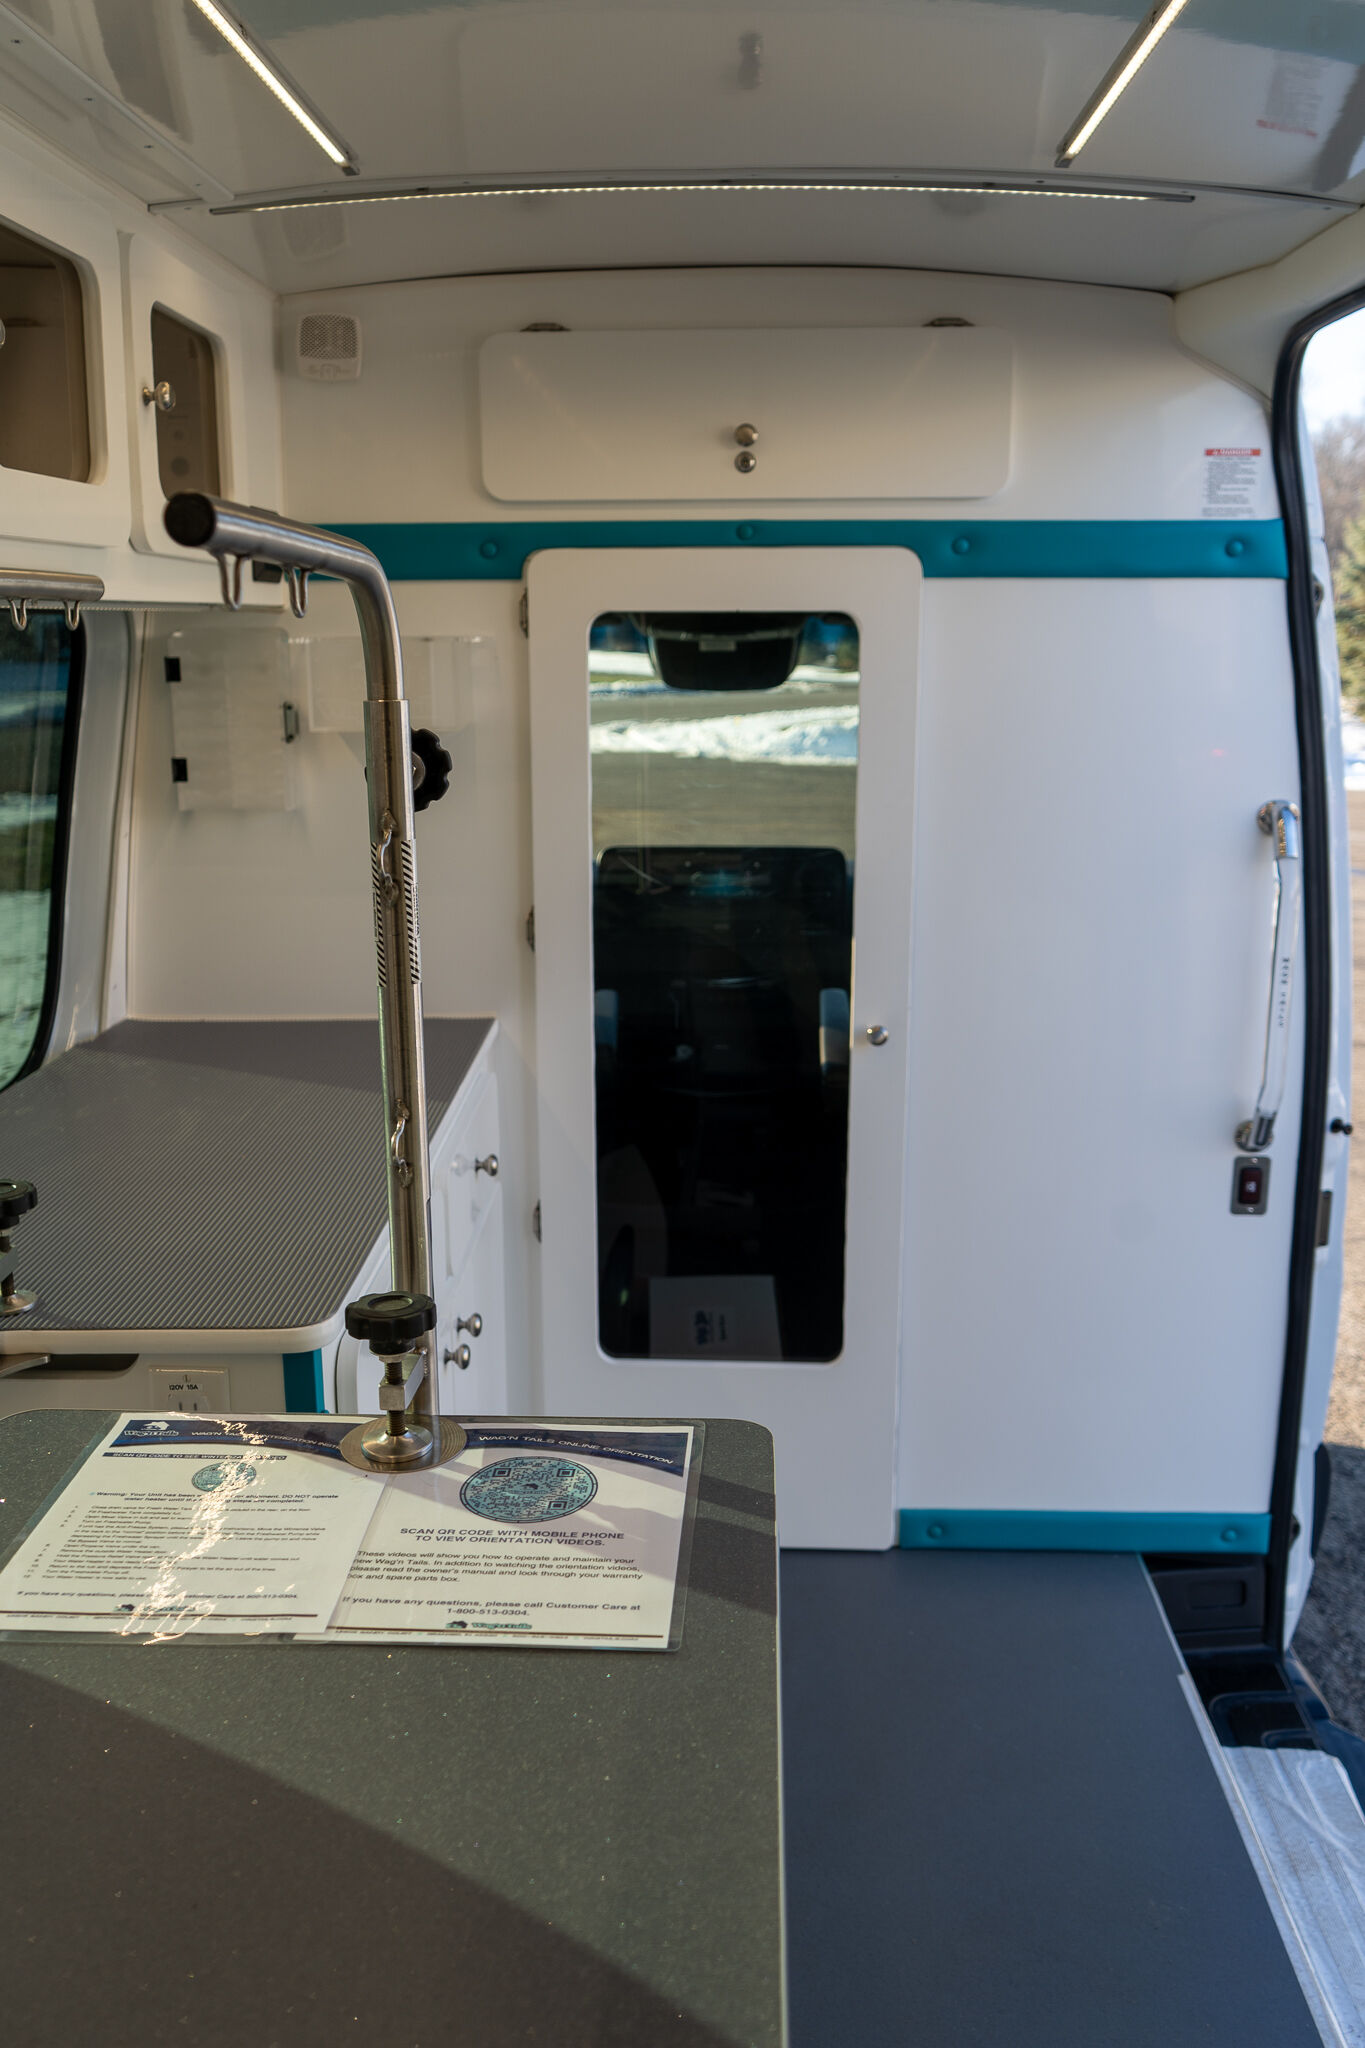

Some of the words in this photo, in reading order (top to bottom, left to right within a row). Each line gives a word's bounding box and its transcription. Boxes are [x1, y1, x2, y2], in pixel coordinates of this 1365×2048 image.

[522, 1436, 555, 1444] TAILS
[558, 1440, 601, 1450] ONLINE
[602, 1446, 675, 1465] ORIENTATION
[400, 1527, 436, 1535] SCAN
[437, 1527, 457, 1535] QR
[459, 1528, 494, 1536] CODE
[497, 1529, 529, 1537] WITH
[531, 1530, 579, 1539] MOBILE
[581, 1531, 626, 1540] PHONE
[435, 1535, 468, 1543] VIEW
[469, 1536, 554, 1545] ORIENTATION
[555, 1538, 606, 1546] VIDEOS.
[387, 1550, 418, 1558] videos
[352, 1557, 373, 1565] new
[374, 1558, 405, 1566] Wag'n
[406, 1558, 431, 1566] Tails.
[495, 1562, 537, 1570] watching
[422, 1567, 459, 1575] owner's
[540, 1571, 577, 1579] through
[578, 1572, 601, 1580] your
[425, 1600, 483, 1608] questions,
[485, 1600, 522, 1608] please
[447, 1608, 530, 1616] 1-800-513-0304.
